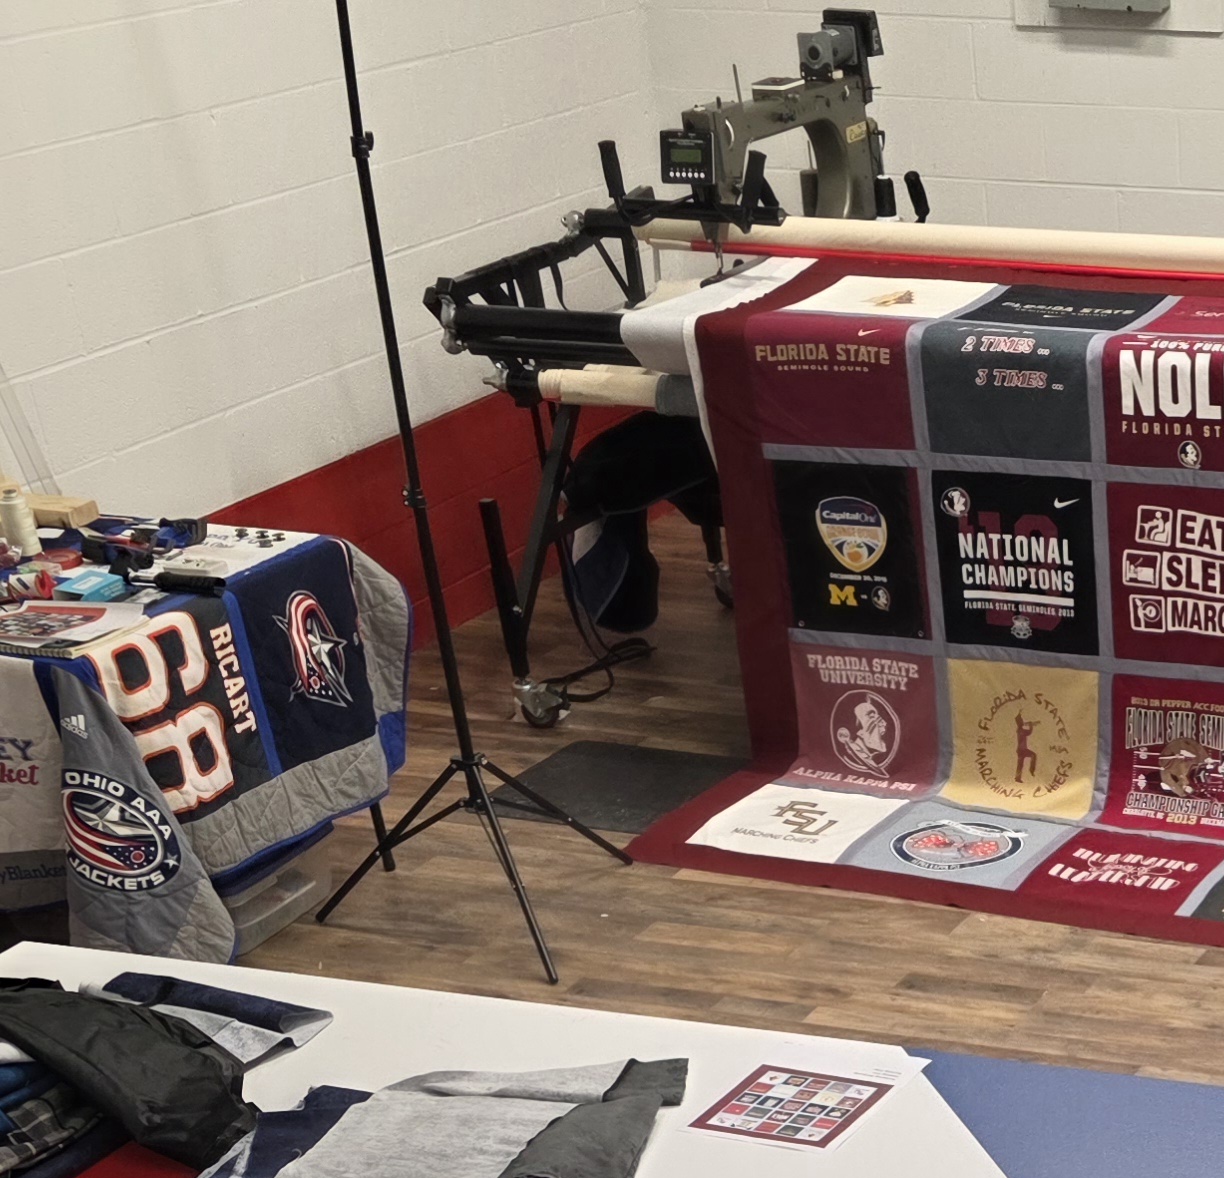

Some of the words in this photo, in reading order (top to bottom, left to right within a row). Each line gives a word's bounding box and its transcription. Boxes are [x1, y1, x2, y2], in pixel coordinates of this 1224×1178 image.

[755, 343, 829, 362] FLORIDA
[836, 345, 890, 365] STATE
[961, 335, 977, 352] 2
[980, 335, 1036, 353] TIMES
[1150, 339, 1190, 350] 100%
[975, 368, 989, 386] 3
[993, 368, 1048, 389] TIMES
[1121, 420, 1193, 436] FLORIDA
[958, 532, 1074, 566] NATIONAL
[961, 563, 1075, 593] CHAMPIONS
[828, 583, 858, 607] M
[964, 600, 994, 610] FLORIDA
[210, 622, 257, 734] RICART
[806, 654, 870, 671] FLORIDA
[872, 658, 919, 678] STATE
[820, 669, 908, 691] UNIVERSITY
[85, 610, 234, 815] 68
[1034, 693, 1070, 740] STATE
[1125, 706, 1164, 750] FLORIDA
[1165, 710, 1197, 742] STATE
[793, 766, 842, 783] ALPHA
[842, 774, 889, 789] KAPPA
[889, 782, 917, 791] PSI
[64, 771, 125, 797] OHIO
[130, 796, 173, 841] AAA
[1126, 791, 1211, 816] CHAMPIONSHIP
[771, 800, 838, 836] FSU
[1166, 813, 1197, 825] 2013
[69, 856, 166, 891] JACKETS
